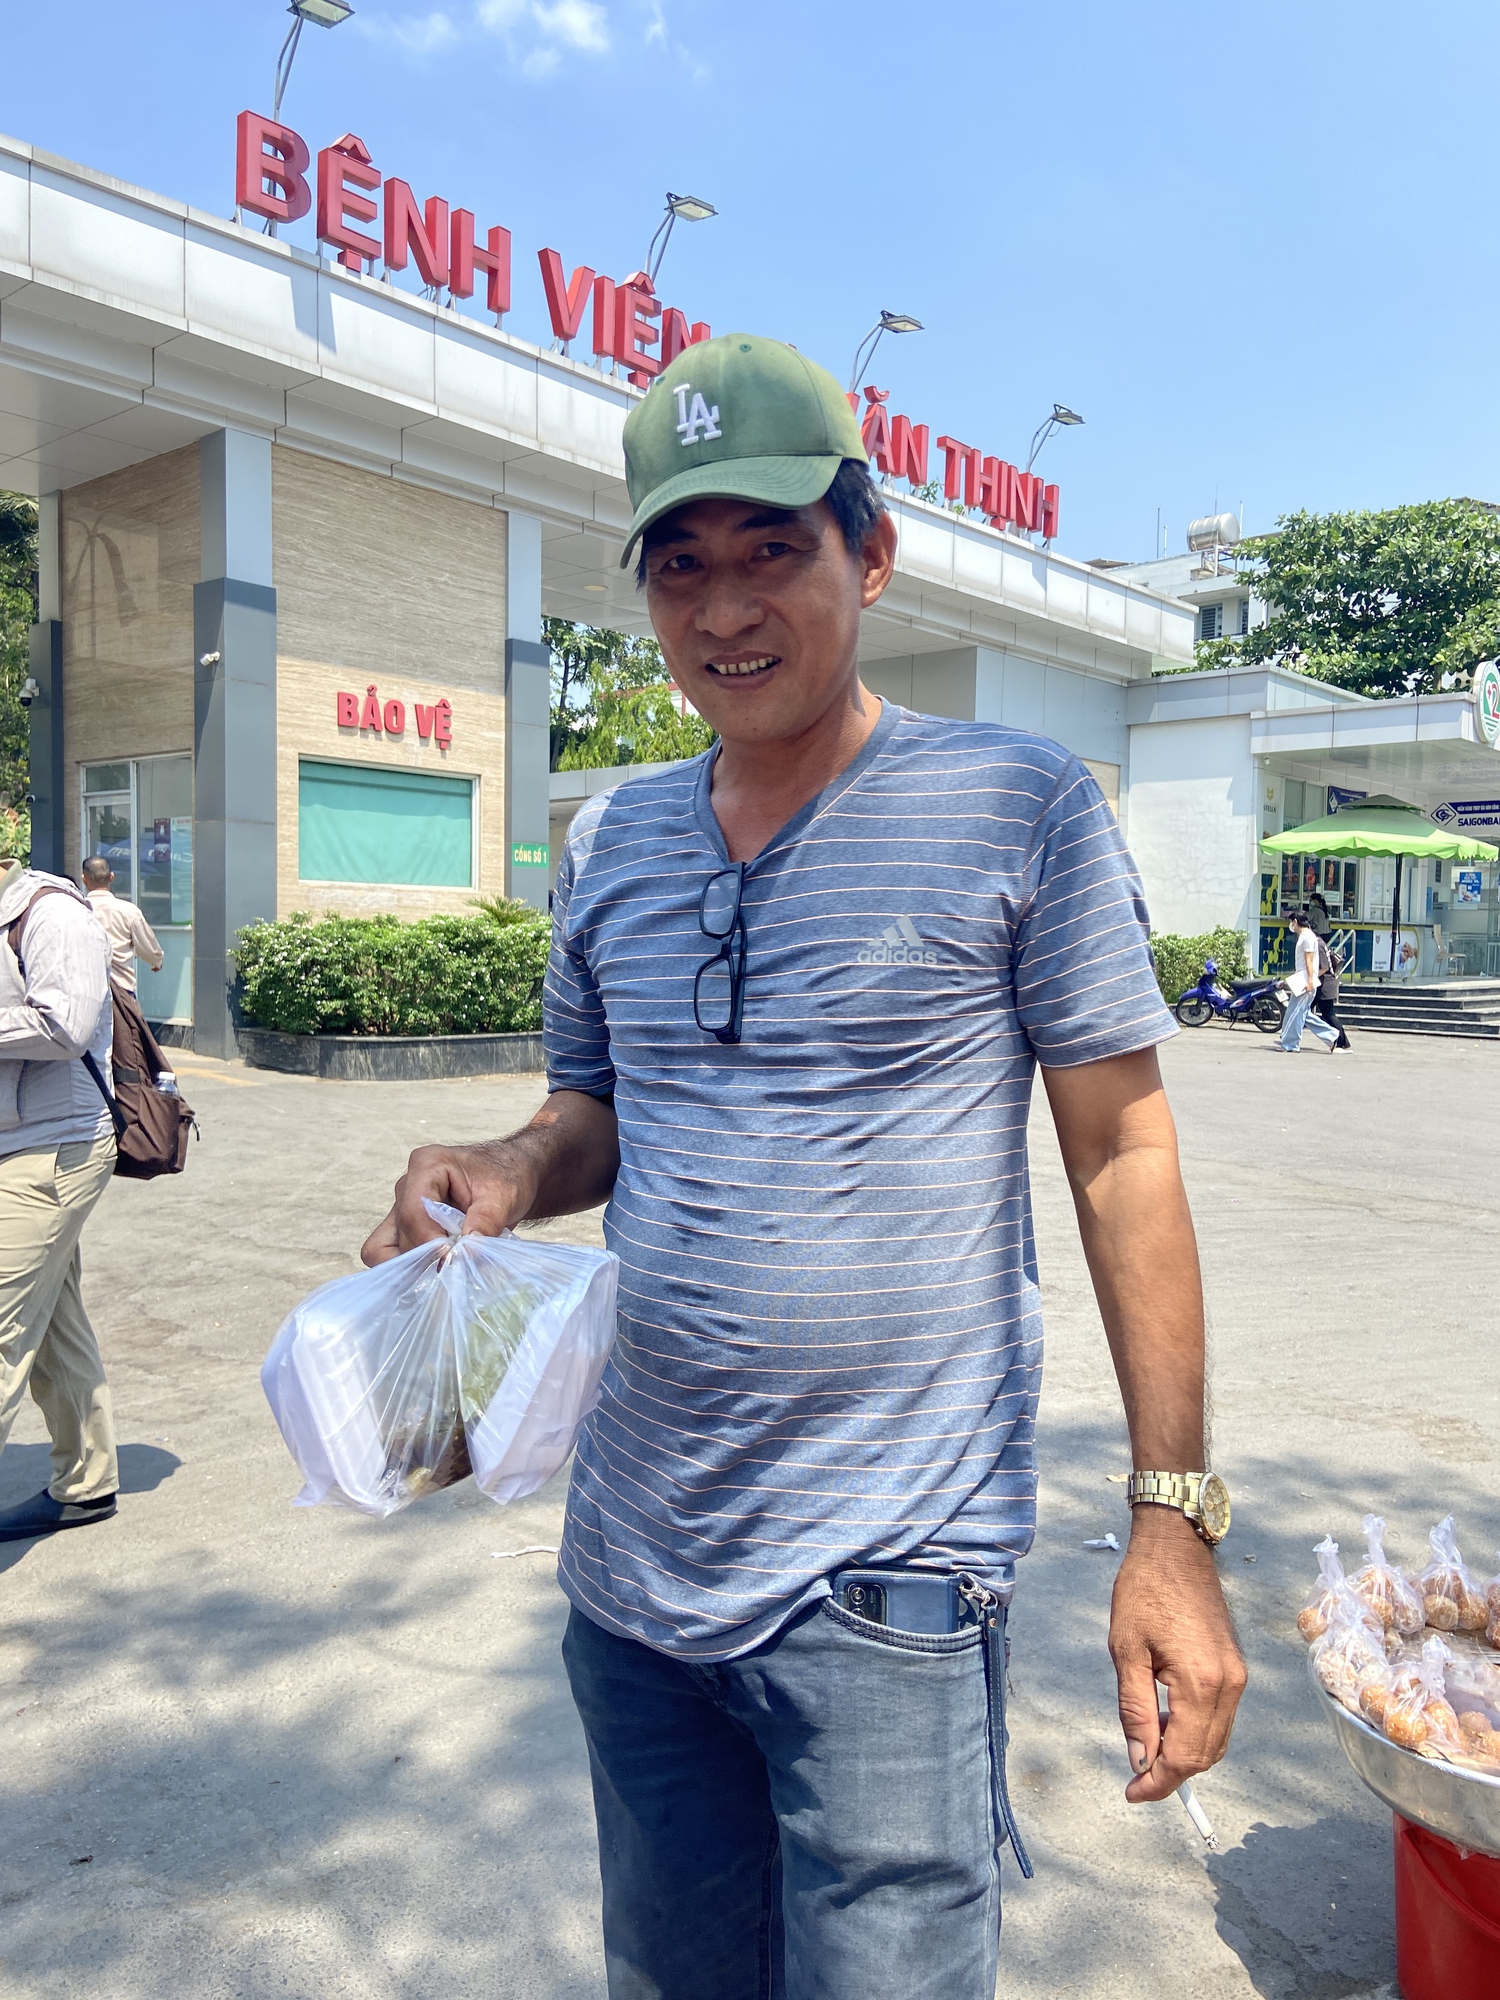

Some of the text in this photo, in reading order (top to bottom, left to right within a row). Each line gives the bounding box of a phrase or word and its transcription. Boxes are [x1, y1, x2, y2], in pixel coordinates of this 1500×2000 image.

[236, 109, 511, 313] BỆNH
[846, 385, 930, 487] ĂN
[936, 435, 1060, 539] THỊNH
[673, 383, 722, 447] LA
[337, 685, 453, 750] BẢO VỆ
[1457, 817, 1500, 827] SAIGONBA
[533, 847, 542, 864] SỐ
[857, 945, 938, 965] adidas
